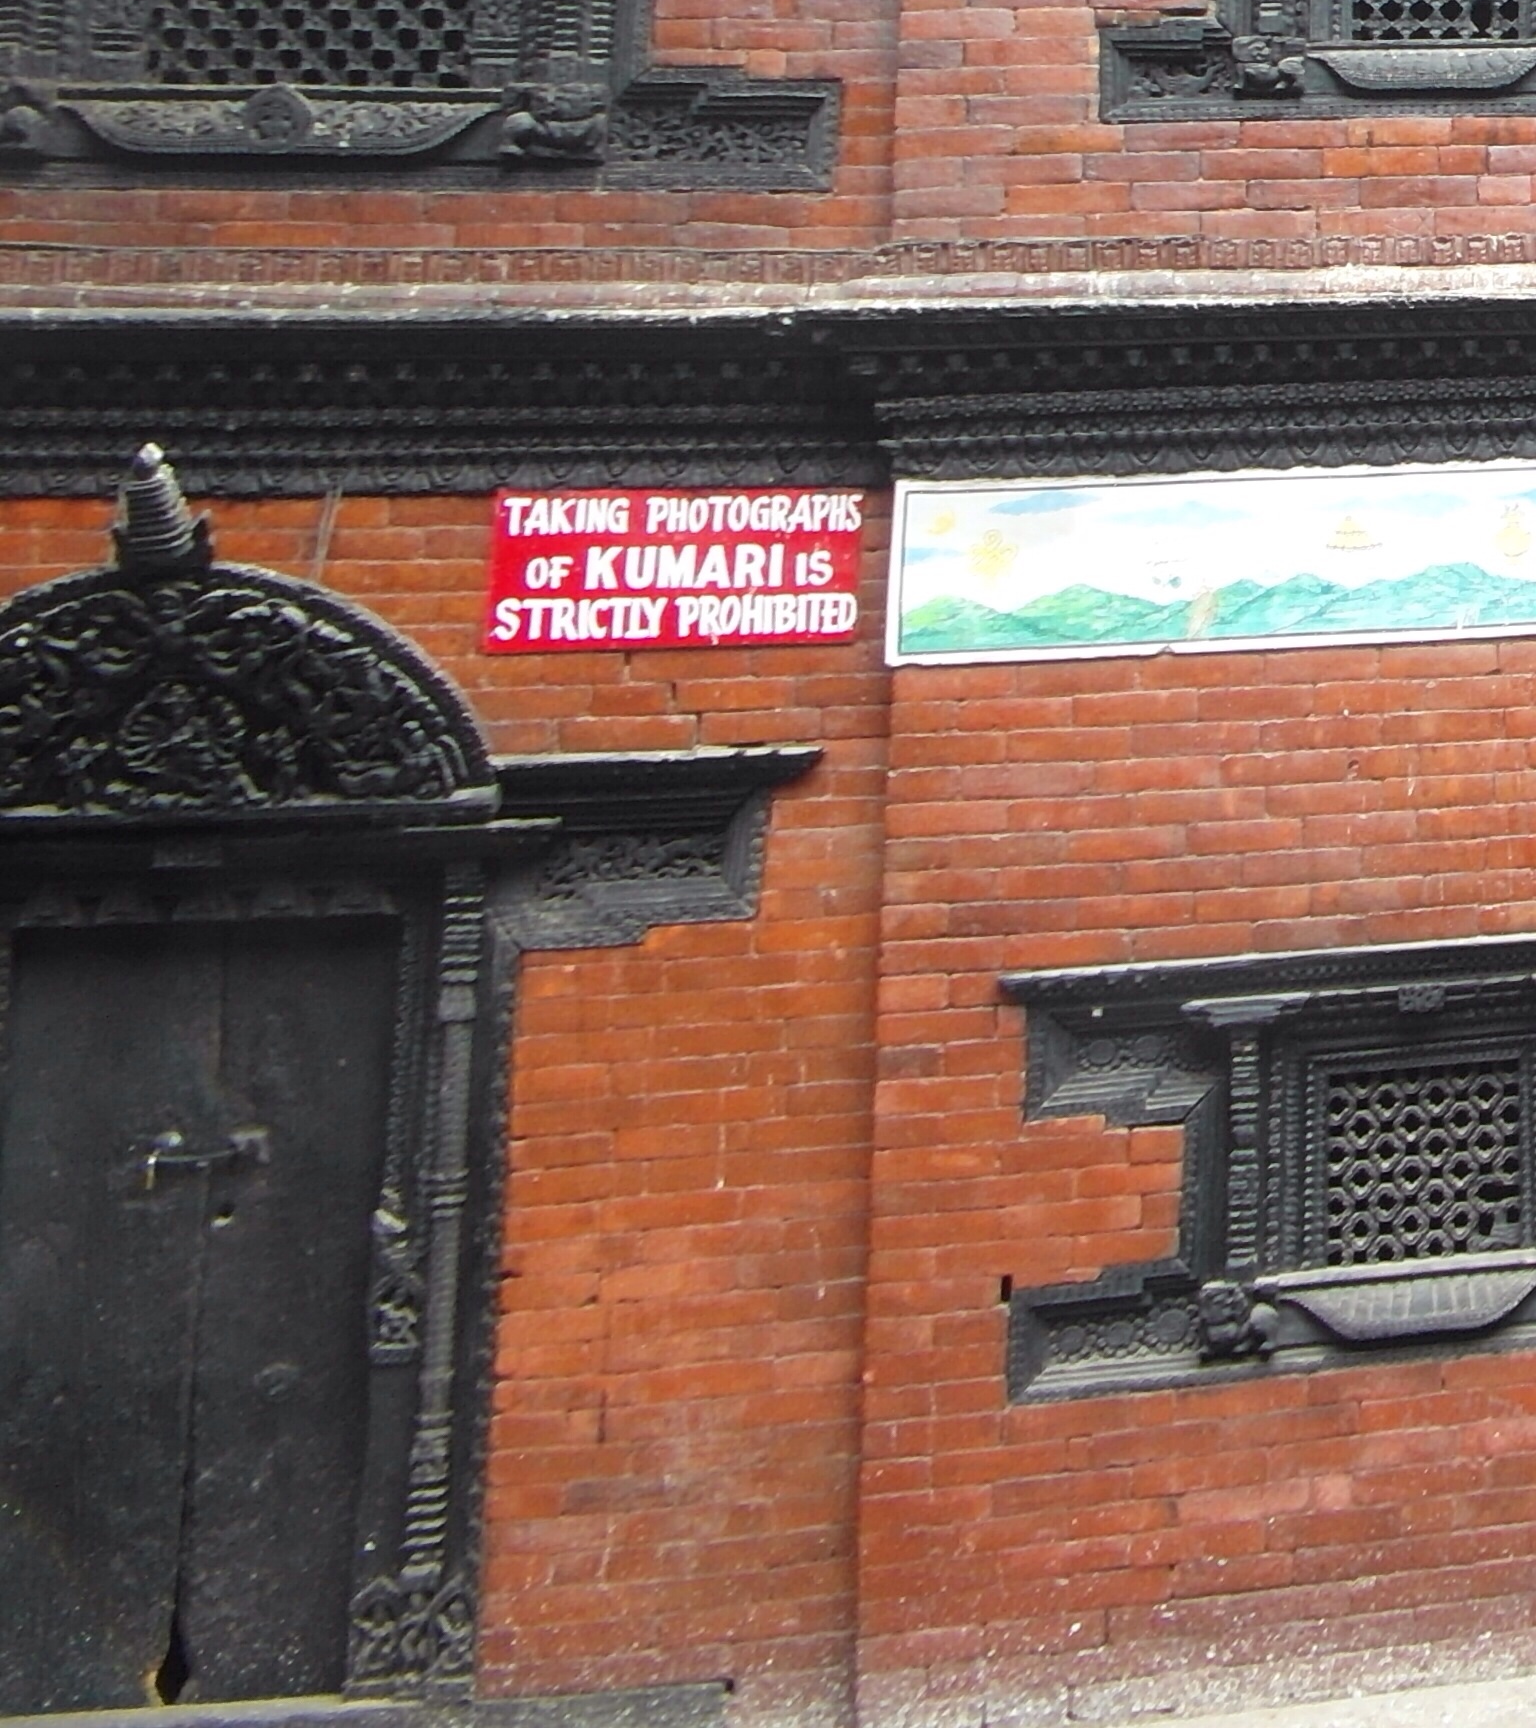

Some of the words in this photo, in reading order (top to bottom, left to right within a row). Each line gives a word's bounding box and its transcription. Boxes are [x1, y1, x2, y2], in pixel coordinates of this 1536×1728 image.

[502, 495, 630, 536] TAKING
[645, 493, 864, 533] PHOTOGRAPHS
[525, 555, 574, 590] OF
[584, 543, 785, 590] KUMARI
[795, 550, 834, 586] IS
[490, 596, 668, 641] STRICTLY
[674, 592, 858, 638] PROHIBITED
